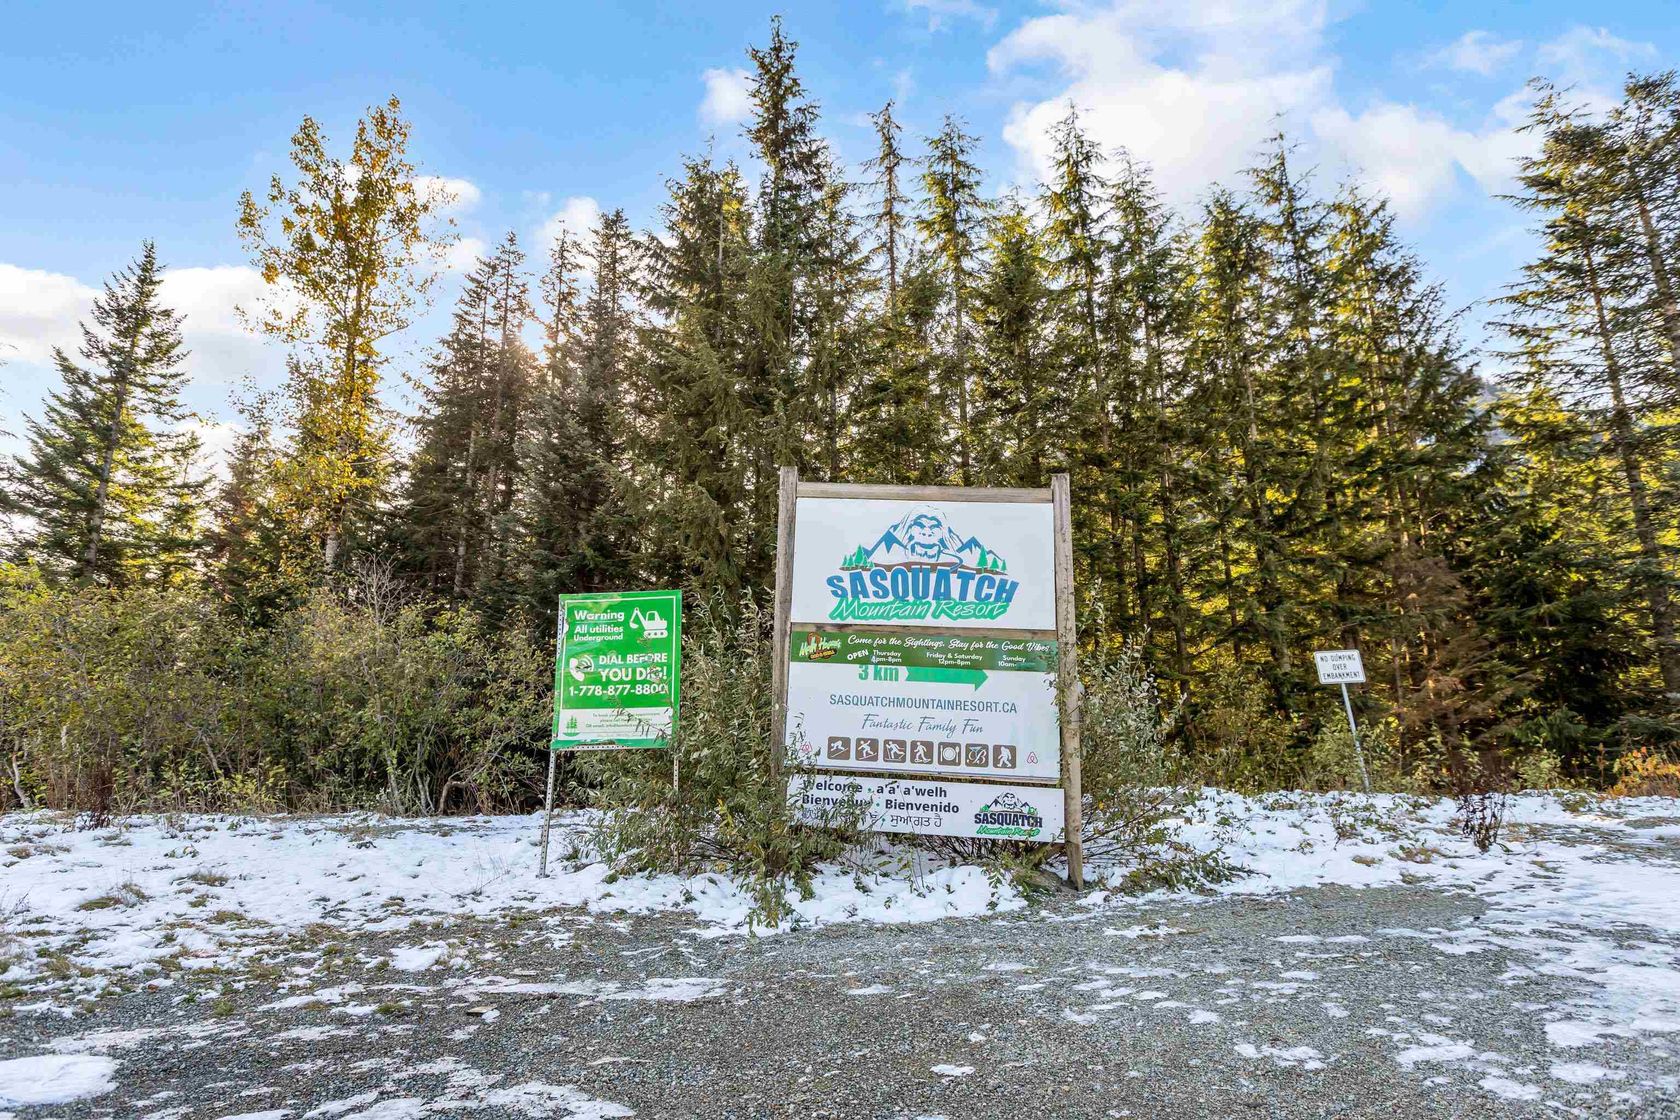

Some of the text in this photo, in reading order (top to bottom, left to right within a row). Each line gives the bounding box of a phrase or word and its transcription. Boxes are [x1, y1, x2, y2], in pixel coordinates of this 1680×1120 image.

[826, 565, 1020, 603] SASQUATCH
[834, 598, 1007, 618] Mountain Resort
[574, 610, 625, 622] Warning
[574, 624, 623, 633] All utilities
[574, 633, 623, 642] Underground
[847, 634, 873, 645] Come
[872, 637, 887, 647] for
[889, 637, 902, 646] the
[948, 638, 969, 650] Stay
[970, 641, 984, 650] for
[986, 640, 999, 649] the
[1001, 640, 1024, 651] Good
[599, 653, 668, 665] DIAL BEFORE
[847, 649, 869, 661] OPEN
[873, 649, 902, 657] Thursday
[926, 652, 946, 660] Friday
[954, 653, 983, 661] Saturday
[858, 664, 900, 682] 3 km
[1332, 663, 1347, 671] OVER
[598, 666, 668, 682] YOU DIG!
[1322, 672, 1360, 680] EMBANKMENT
[569, 684, 668, 696] 1-778-877-8800
[829, 694, 1018, 714] SASQUATCHMOUNTAINRESORT.CA
[861, 713, 983, 739] Fantastic Family Fun
[802, 794, 960, 814] Bienveu Bienvenido
[974, 813, 1042, 828] SASQUATCH
